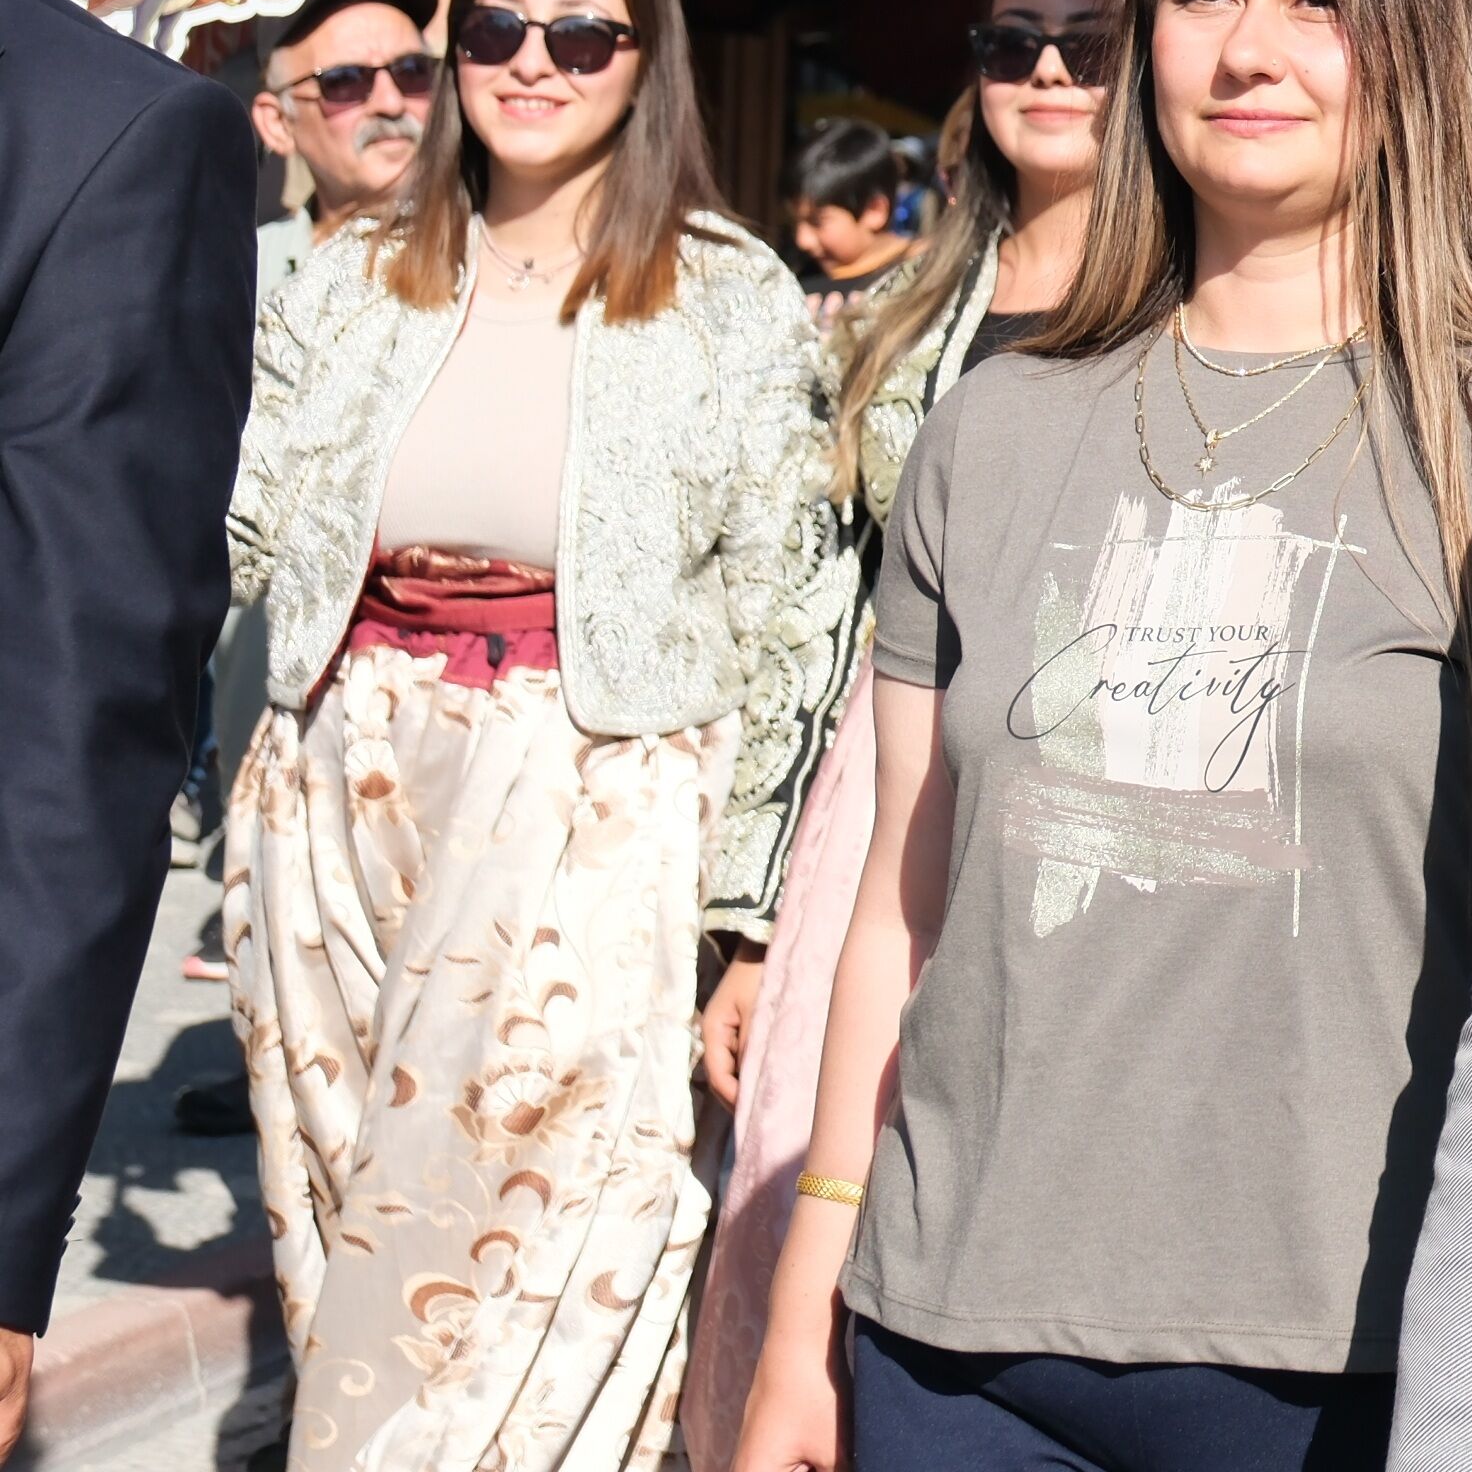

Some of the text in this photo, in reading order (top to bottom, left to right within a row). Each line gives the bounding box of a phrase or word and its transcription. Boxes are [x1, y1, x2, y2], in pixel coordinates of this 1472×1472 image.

[1125, 624, 1270, 643] TRUST YOUR
[1006, 622, 1312, 793] Creativity
